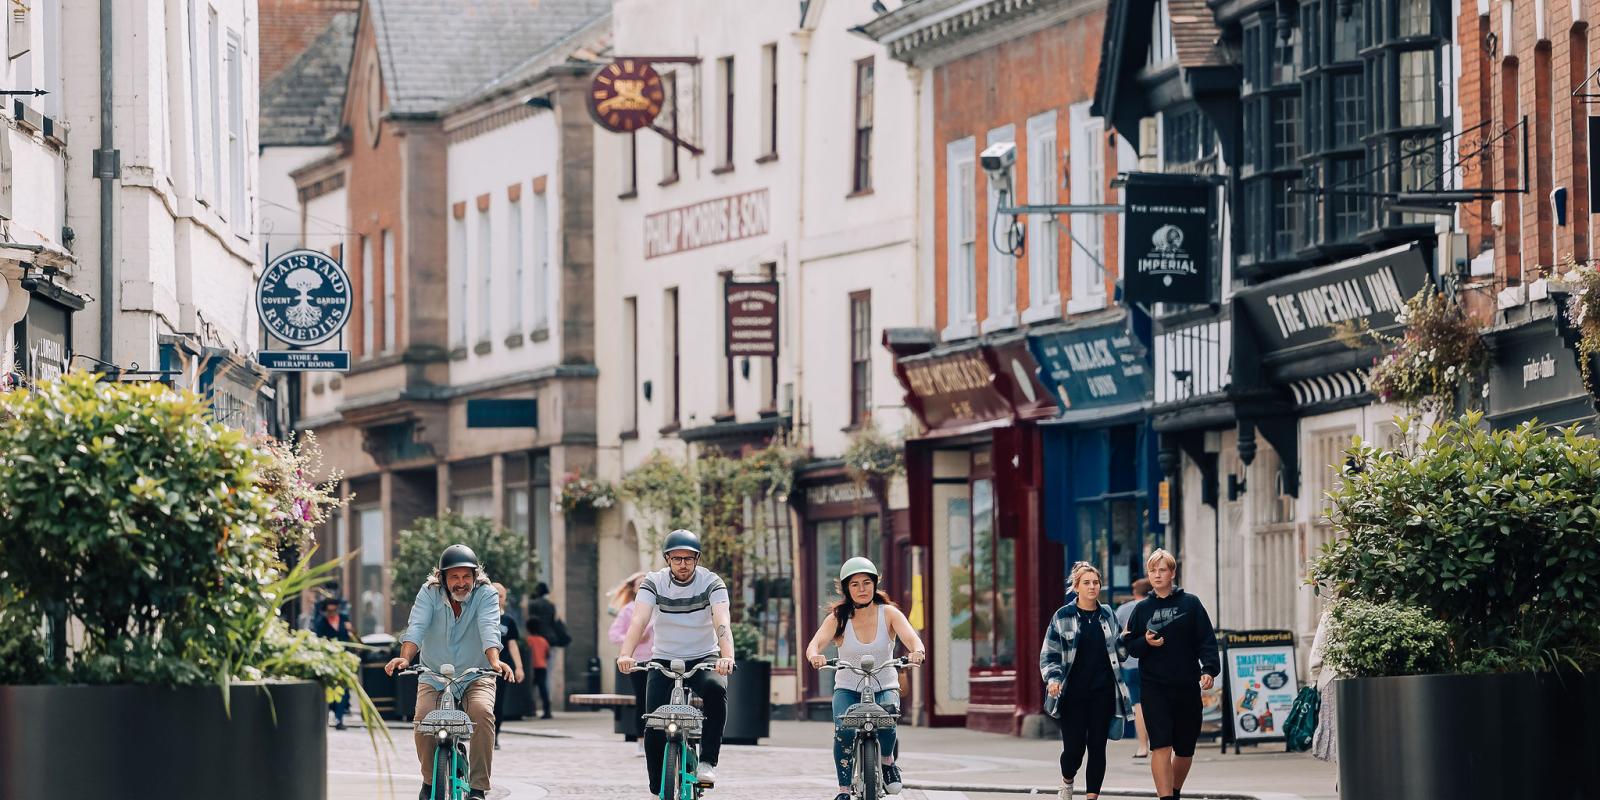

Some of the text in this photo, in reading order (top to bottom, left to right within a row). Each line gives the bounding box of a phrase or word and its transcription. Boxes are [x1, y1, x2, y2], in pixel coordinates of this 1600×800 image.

[1131, 204, 1206, 215] THE IMPERIAL INN
[645, 192, 768, 258] PHILIP MORRIS & SON
[263, 256, 345, 293] NEAL'S YARD
[1138, 258, 1198, 274] IMPERIAL
[1267, 266, 1404, 339] THE IMPERIAL INN
[265, 308, 342, 340] REMEDIES
[1228, 634, 1247, 642] The
[1249, 633, 1291, 643] Imperial
[1237, 665, 1255, 678] QUIZ
